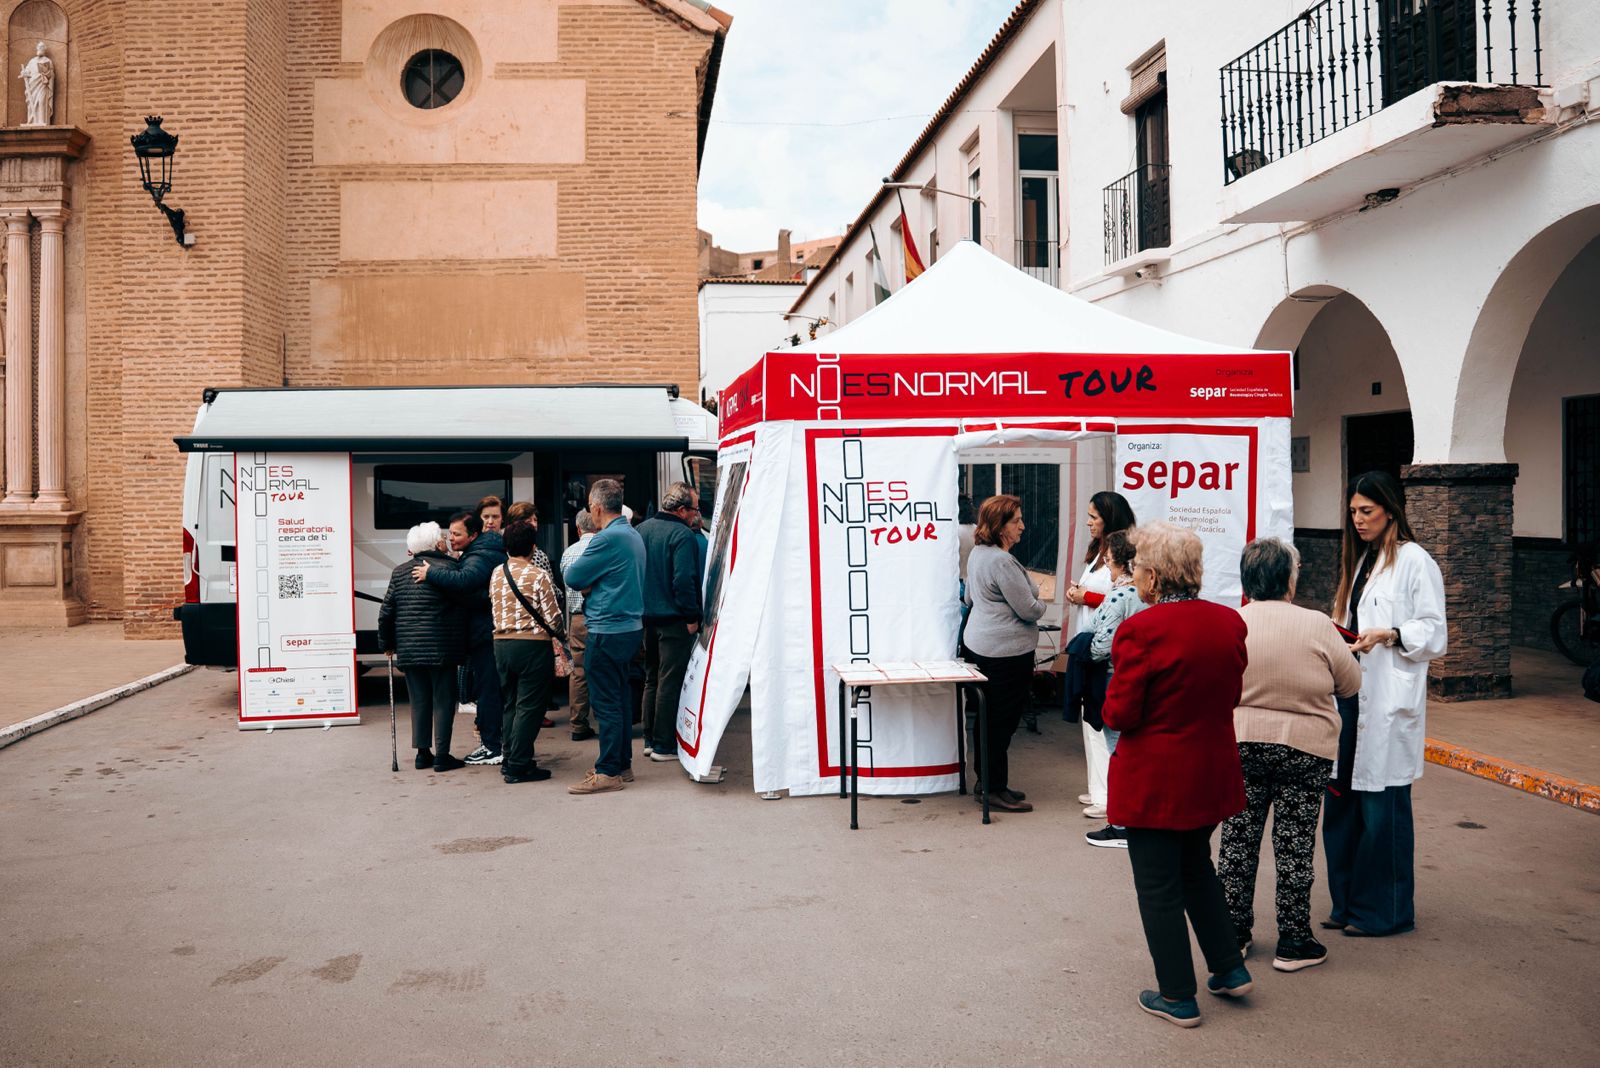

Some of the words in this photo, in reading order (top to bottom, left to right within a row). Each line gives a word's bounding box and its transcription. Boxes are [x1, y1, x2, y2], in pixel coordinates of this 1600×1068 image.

[1058, 365, 1157, 398] TOUR
[1189, 386, 1227, 400] separ
[1127, 442, 1162, 452] Organiza:
[1122, 460, 1240, 499] separ
[270, 491, 305, 503] TOUR
[1169, 506, 1201, 514] Sociedad
[1202, 507, 1232, 515] Española
[277, 518, 305, 526] Salud
[1178, 515, 1219, 525] Neumología
[277, 526, 336, 534] respiratoria,
[870, 522, 938, 546] TOUR
[278, 534, 306, 542] cerca
[286, 638, 312, 648] separ
